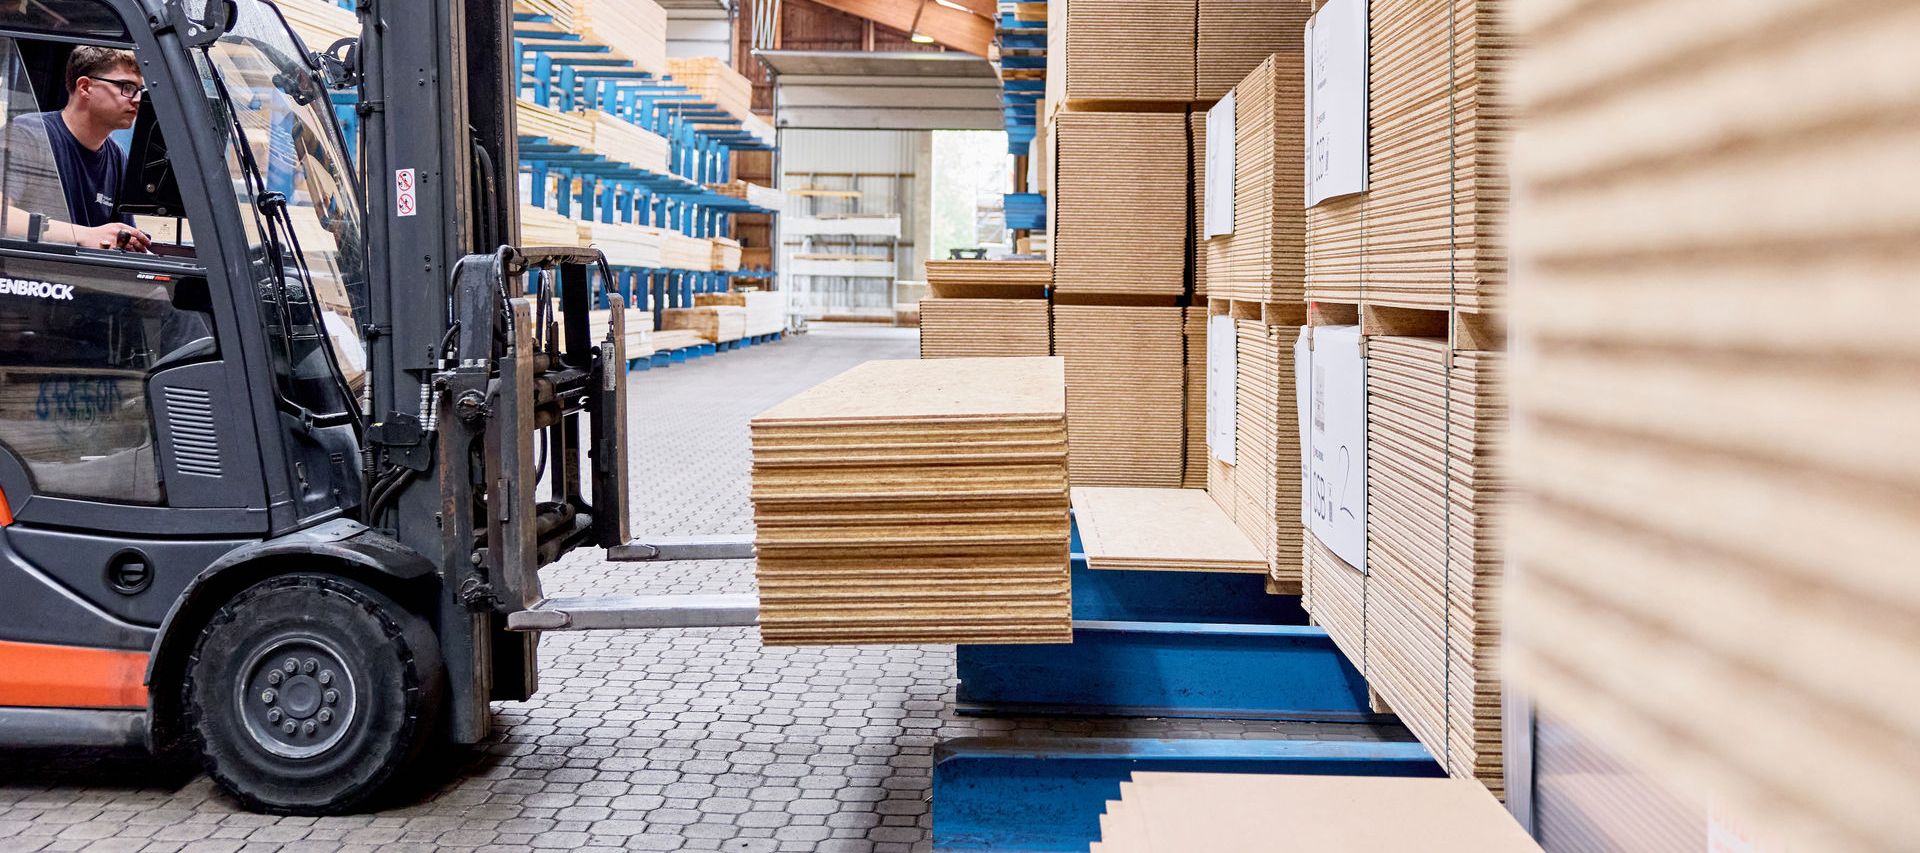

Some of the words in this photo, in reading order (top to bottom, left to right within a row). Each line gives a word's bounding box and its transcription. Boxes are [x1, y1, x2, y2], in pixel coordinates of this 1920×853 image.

[0, 278, 74, 300] ENBROCK
[1313, 471, 1326, 520] OSB
[1339, 445, 1355, 520] 2
